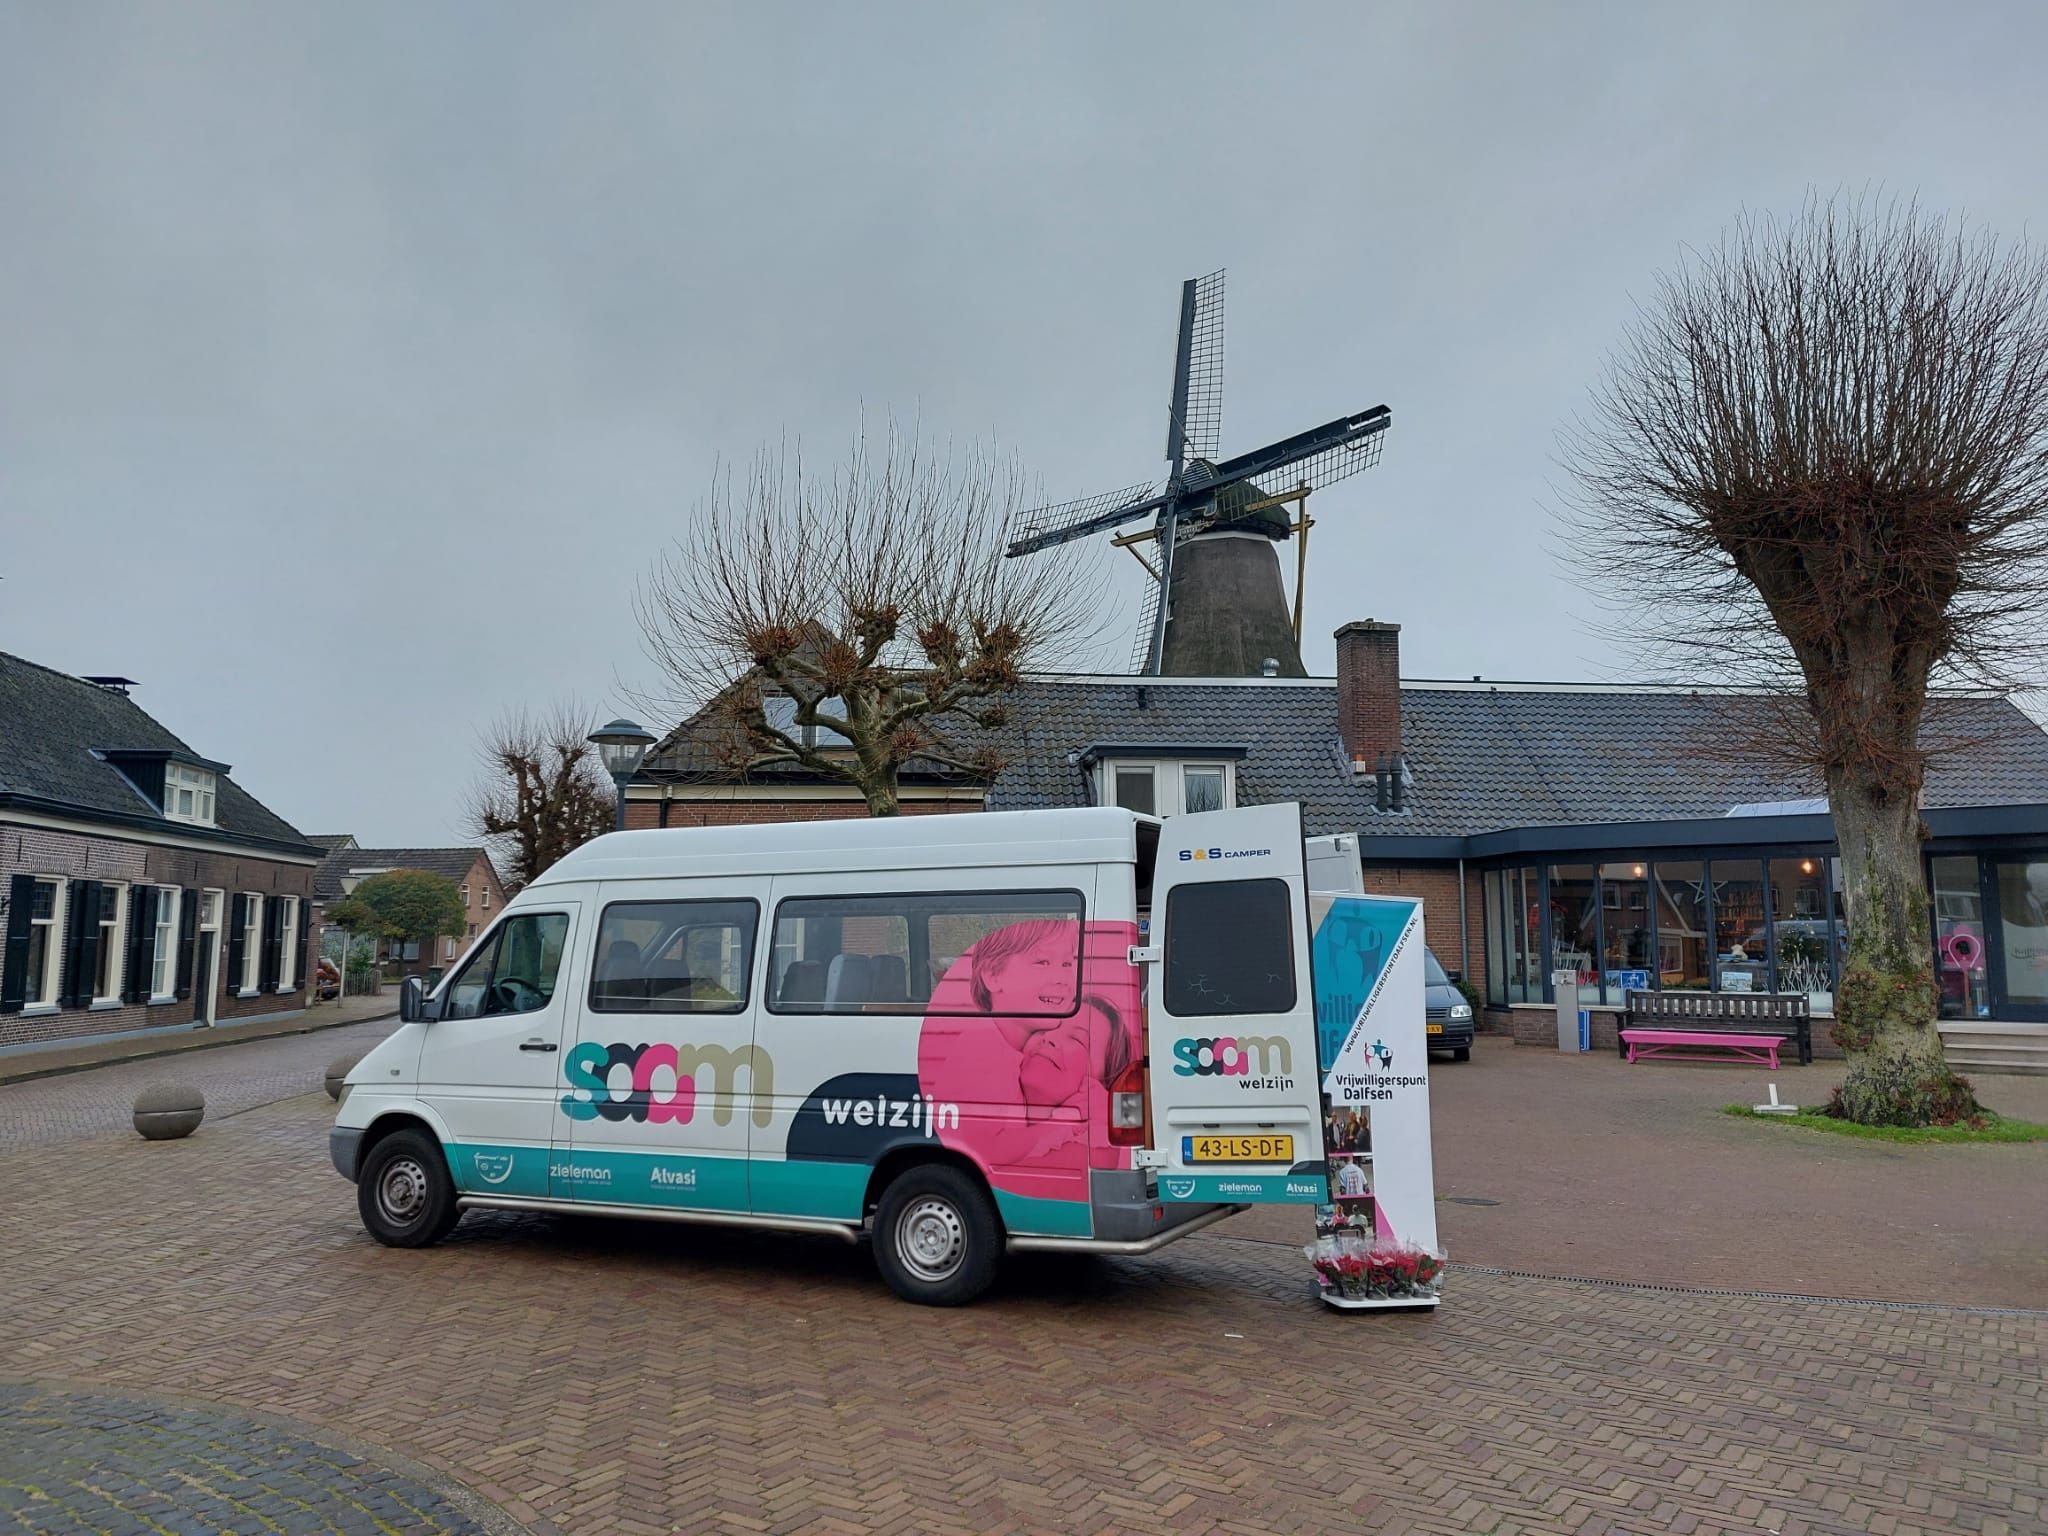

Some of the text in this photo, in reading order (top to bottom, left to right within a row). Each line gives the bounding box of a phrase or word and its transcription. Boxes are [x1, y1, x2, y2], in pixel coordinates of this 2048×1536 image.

[1224, 849, 1271, 858] CAMPER
[1239, 1076, 1294, 1092] welzijn
[1335, 1073, 1426, 1088] Vrijwilligerspunt
[1344, 1087, 1393, 1100] Dalfsen
[821, 1093, 960, 1138] welzijn
[1200, 1139, 1284, 1157] 43-LS-DF
[550, 1163, 612, 1180] zieleman
[650, 1167, 697, 1185] Alvasi
[1218, 1183, 1262, 1192] zieleman
[1286, 1183, 1318, 1193] Alvasi
